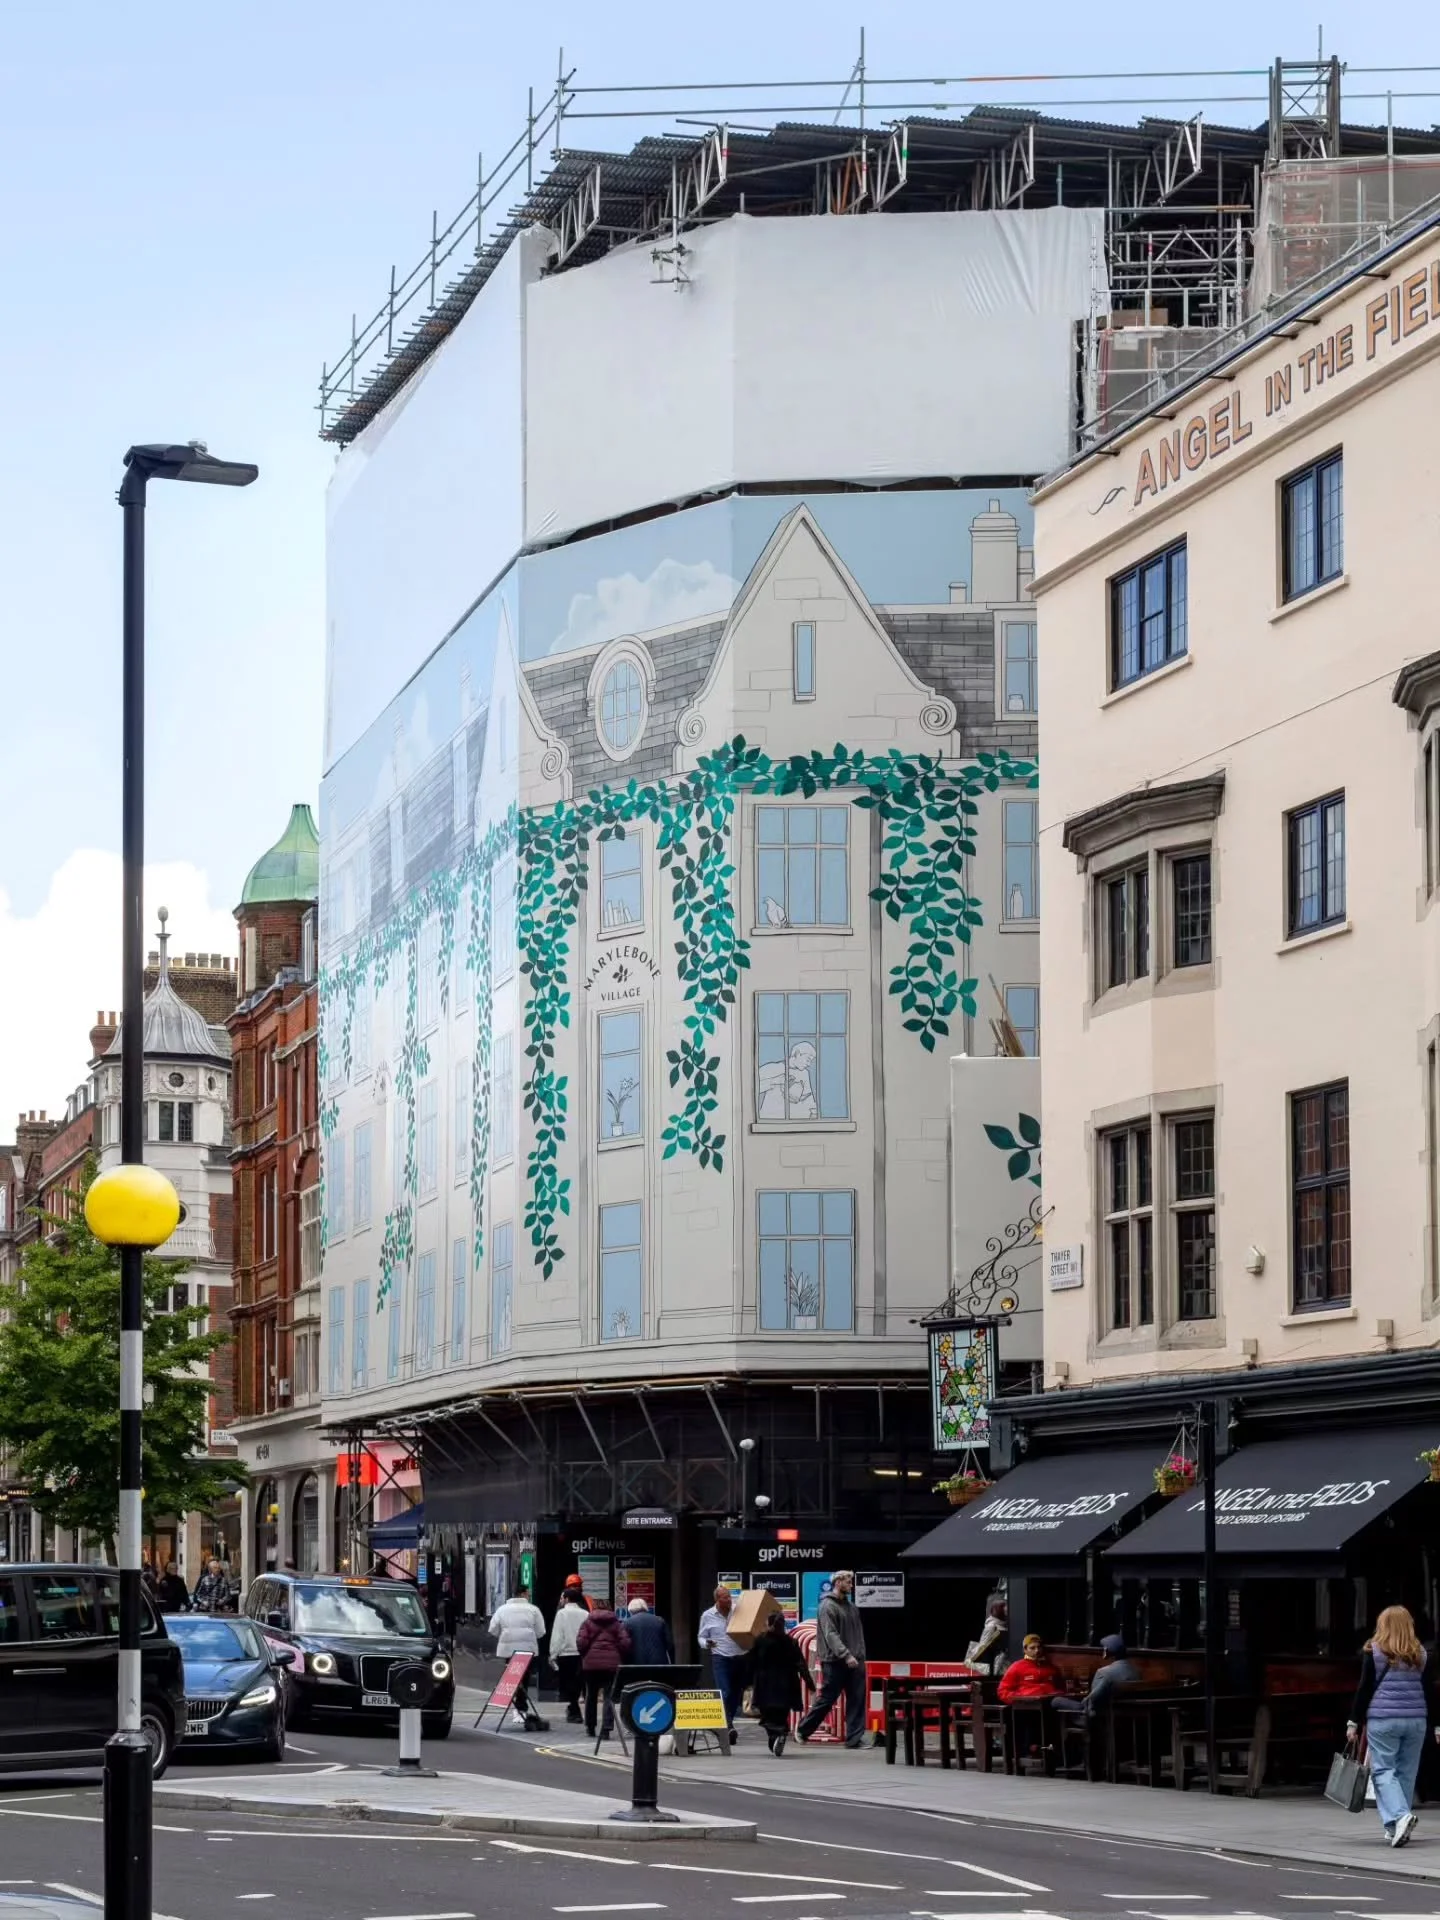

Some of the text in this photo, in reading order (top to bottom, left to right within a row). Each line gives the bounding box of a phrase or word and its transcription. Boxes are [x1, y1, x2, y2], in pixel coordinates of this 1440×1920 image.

[1134, 390, 1253, 506] ANGEL
[1265, 363, 1291, 417] IN
[1298, 324, 1353, 393] THE
[584, 945, 662, 991] MARYLEBONE
[601, 987, 641, 1001] VILLAGE
[1051, 1263, 1069, 1276] STREET
[1271, 1492, 1314, 1509] THE
[1297, 1479, 1391, 1508] FIELDS
[970, 1498, 1040, 1519] ANGEL
[1056, 1492, 1130, 1517] FIELDS
[626, 1517, 673, 1525] SITE ENTRANCE
[1229, 1513, 1270, 1524] SERVED
[1262, 1511, 1311, 1523] UPSTAIRS
[410, 1682, 417, 1692] 3
[365, 1696, 388, 1705] LR69
